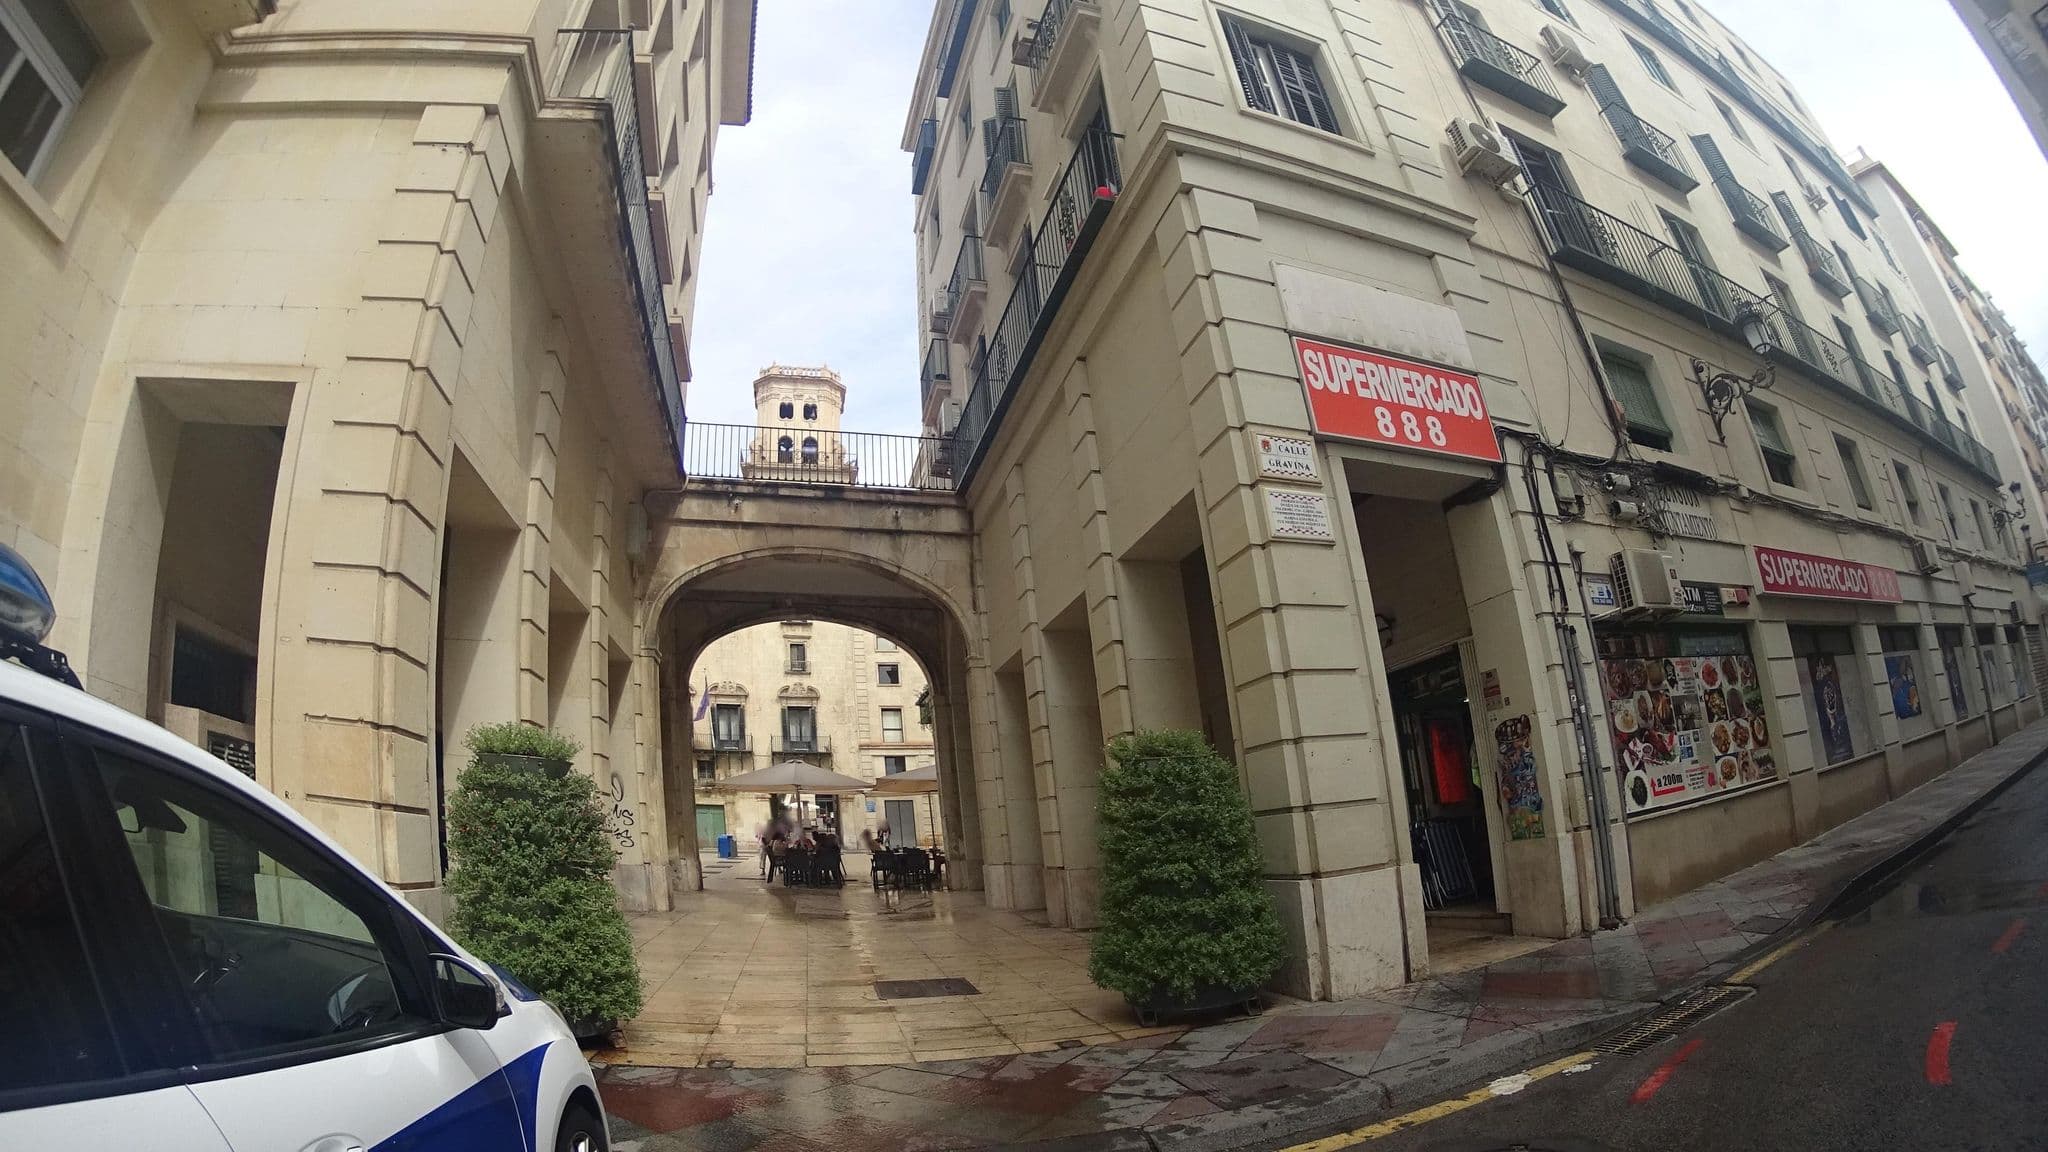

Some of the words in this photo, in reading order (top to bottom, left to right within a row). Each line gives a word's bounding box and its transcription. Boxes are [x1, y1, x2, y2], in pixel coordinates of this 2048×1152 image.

[1303, 349, 1484, 421] SUPERMERCADO
[1277, 444, 1309, 456] CALLE
[1268, 458, 1311, 472] GRAVINA
[1760, 552, 1870, 594] SUPERMERCADO
[1662, 773, 1683, 787] 200m
